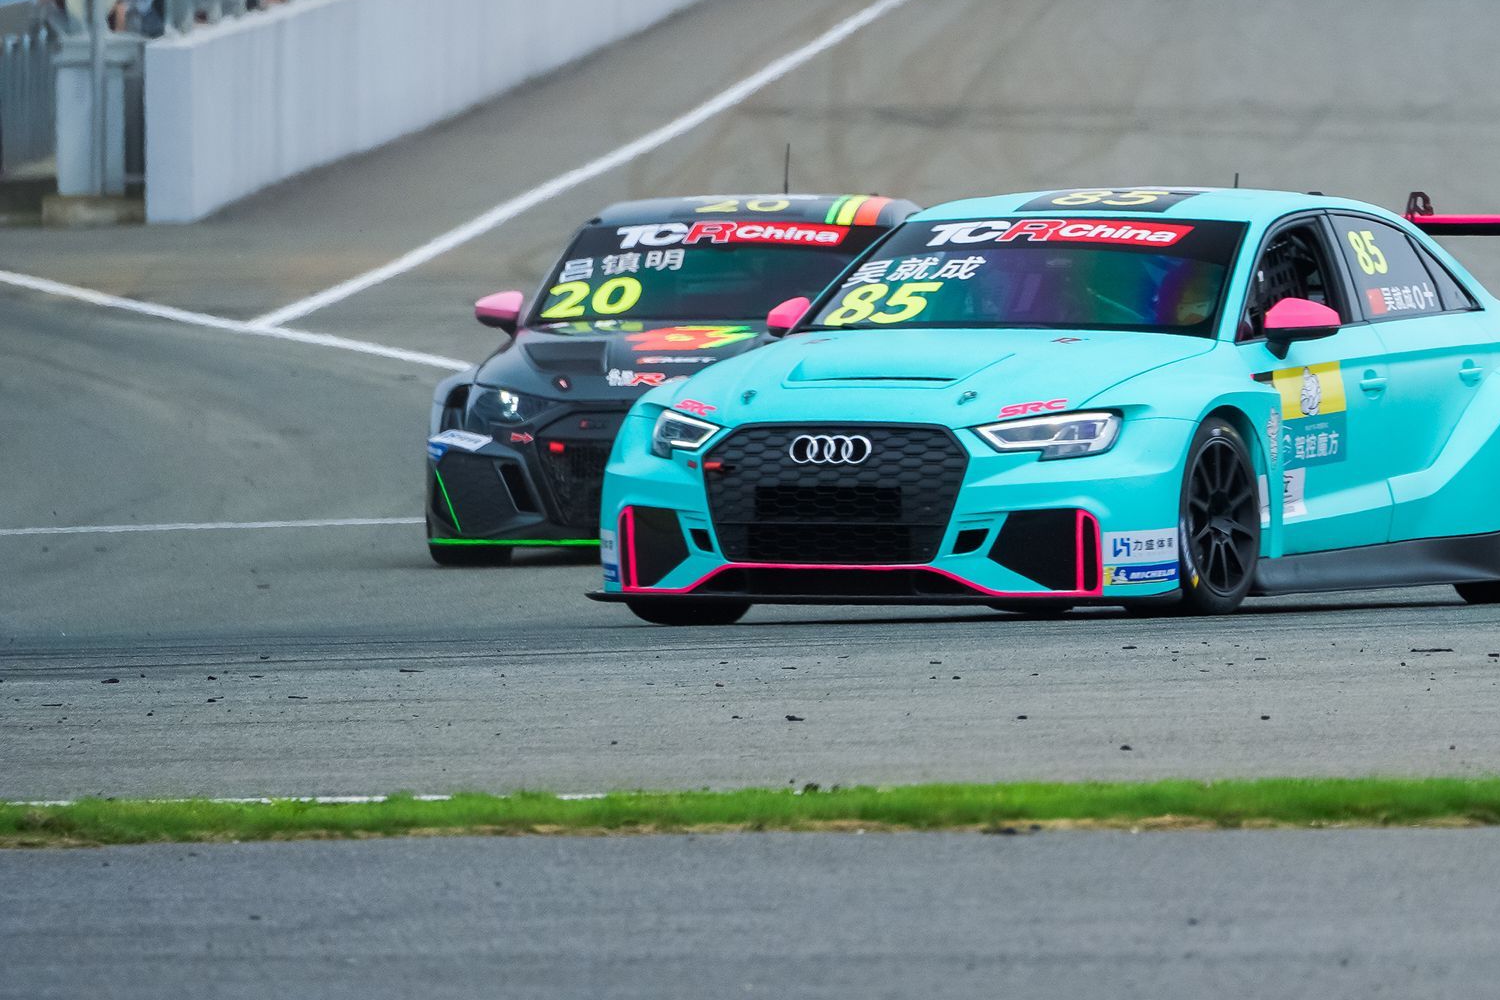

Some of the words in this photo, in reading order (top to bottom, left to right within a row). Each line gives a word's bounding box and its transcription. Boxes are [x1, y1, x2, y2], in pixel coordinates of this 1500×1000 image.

[696, 200, 790, 213] 20
[1051, 190, 1169, 206] 85
[616, 221, 737, 249] TCR
[735, 225, 840, 243] China
[930, 219, 1066, 247] TCR
[1059, 223, 1178, 243] China
[559, 248, 686, 284] 吕镇明
[1347, 230, 1389, 276] 85
[841, 256, 986, 289] 吴就成
[540, 276, 643, 319] 20
[823, 282, 944, 327] 85
[997, 398, 1068, 419] SRC
